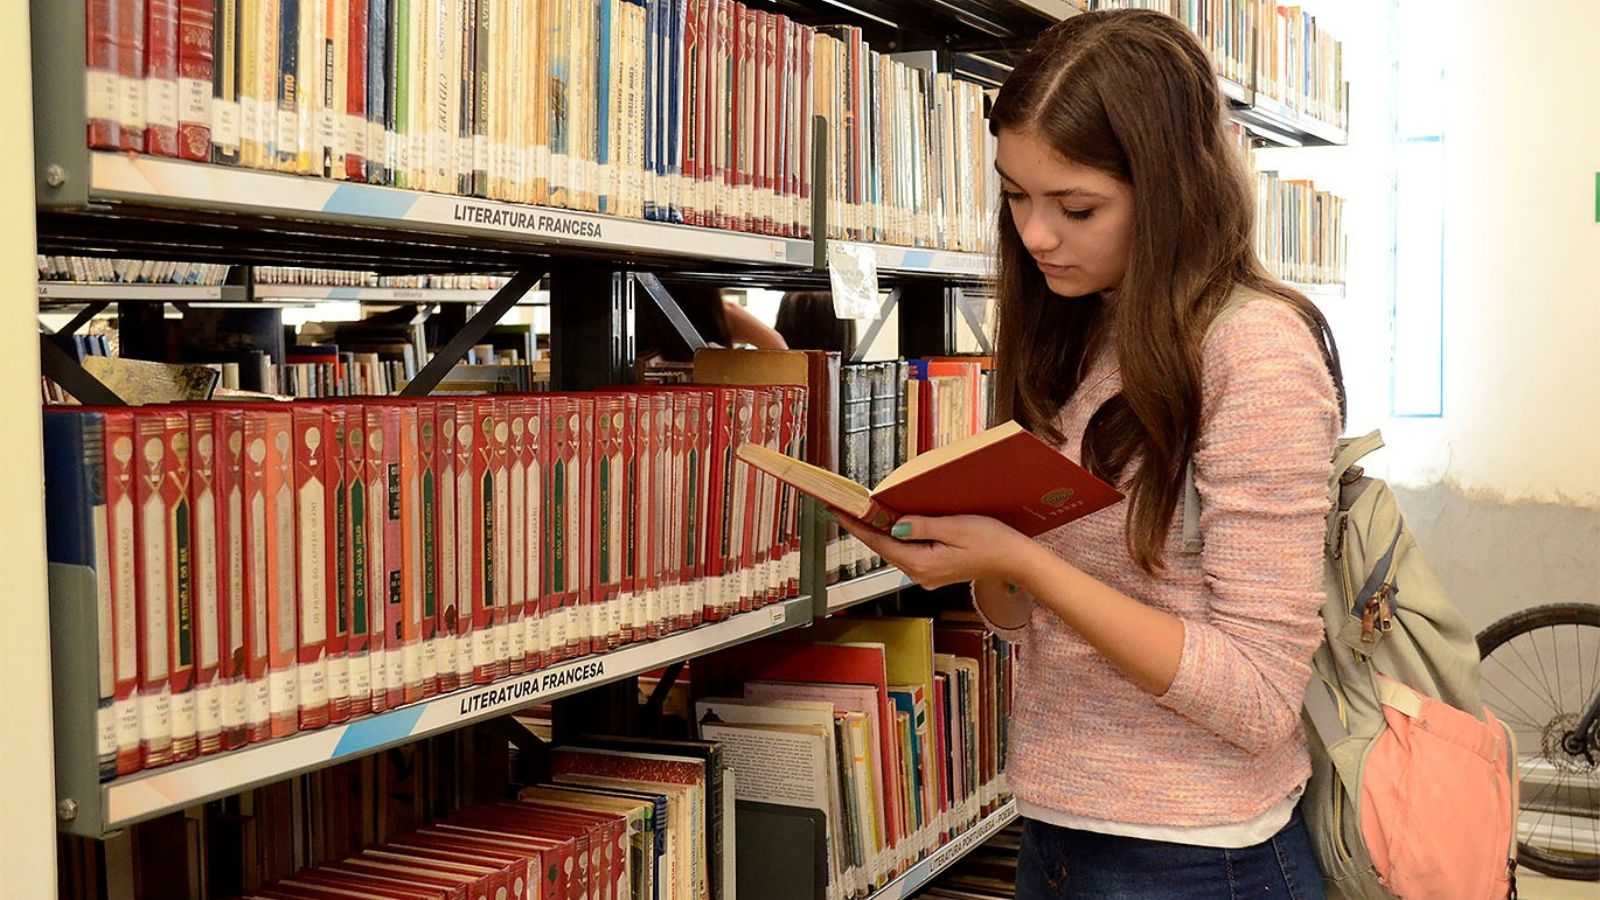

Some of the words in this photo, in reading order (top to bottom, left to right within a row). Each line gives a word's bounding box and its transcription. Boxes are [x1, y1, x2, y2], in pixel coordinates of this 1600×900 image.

[454, 204, 535, 230] LITERATURA
[538, 215, 602, 238] FRANCESA
[460, 678, 540, 715] LITERATURA
[542, 661, 604, 691] FRANCESA
